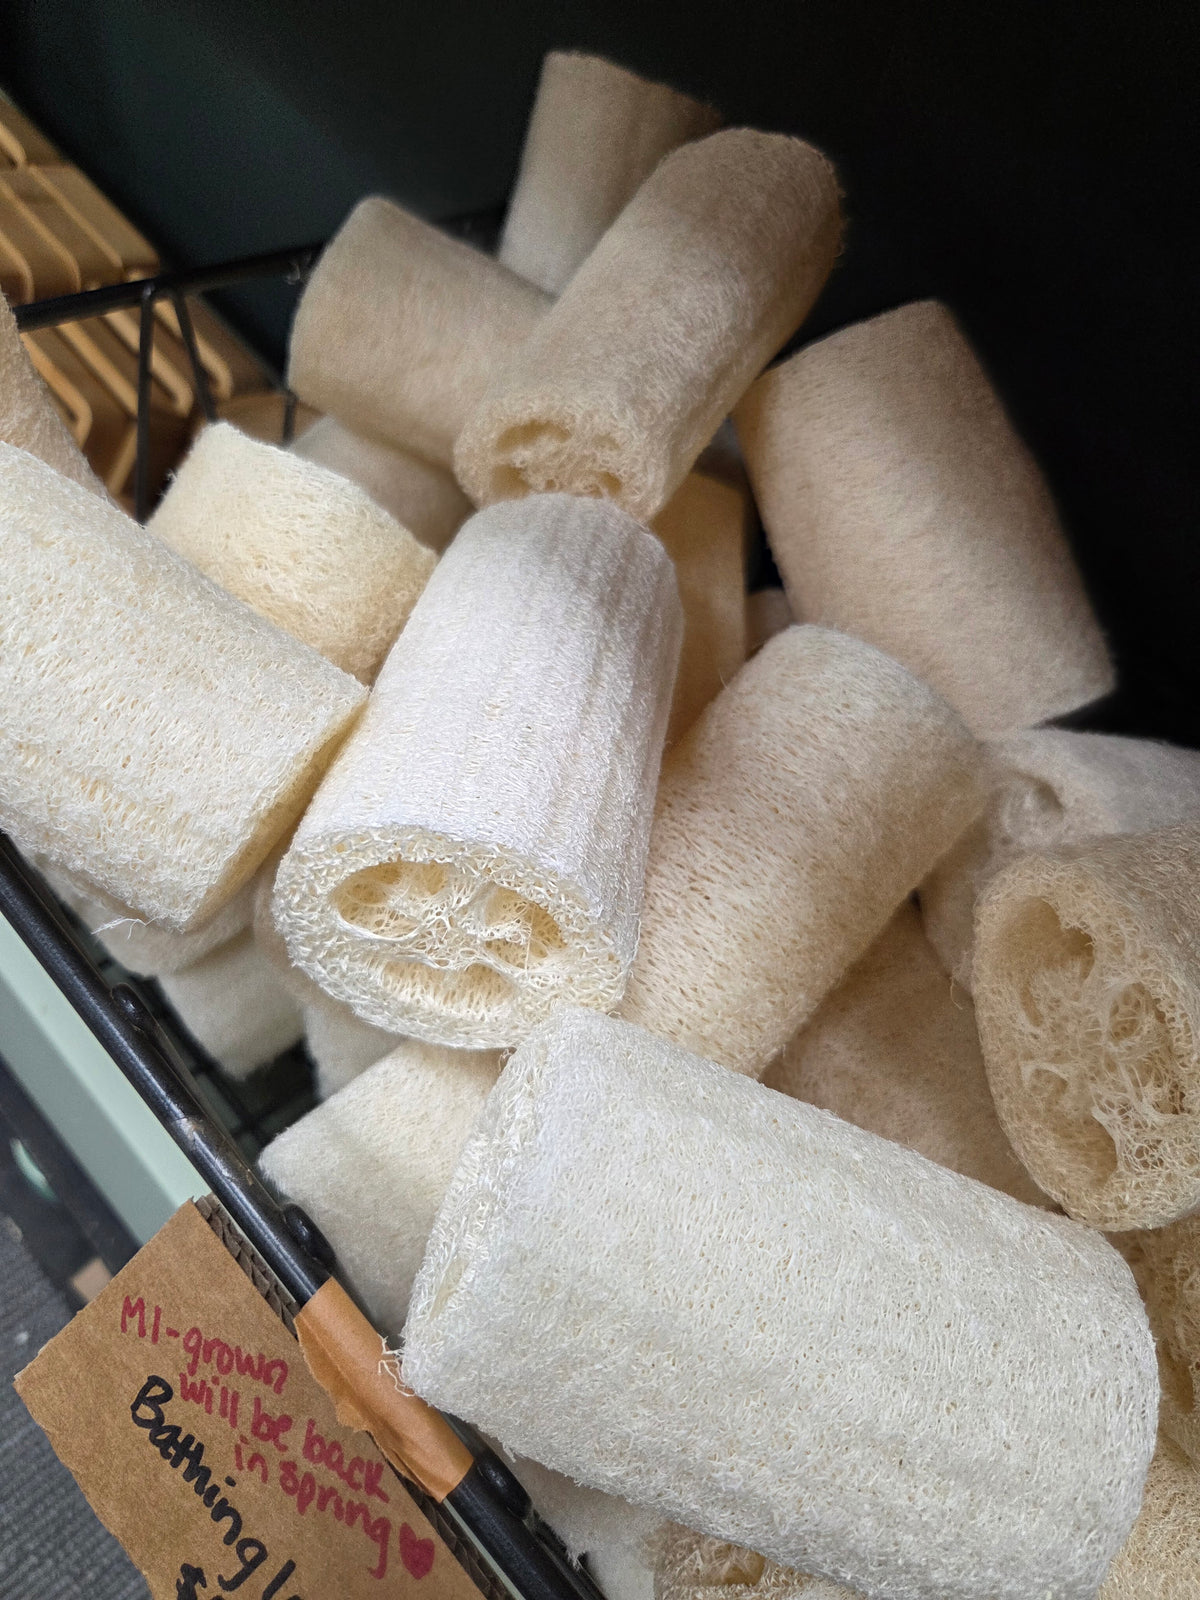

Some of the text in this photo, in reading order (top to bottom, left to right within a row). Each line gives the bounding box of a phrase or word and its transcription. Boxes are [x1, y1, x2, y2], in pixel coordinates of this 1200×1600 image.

[130, 1375, 268, 1592] Bathing
[179, 1372, 391, 1503] will be back
[235, 1436, 392, 1579] in spring
